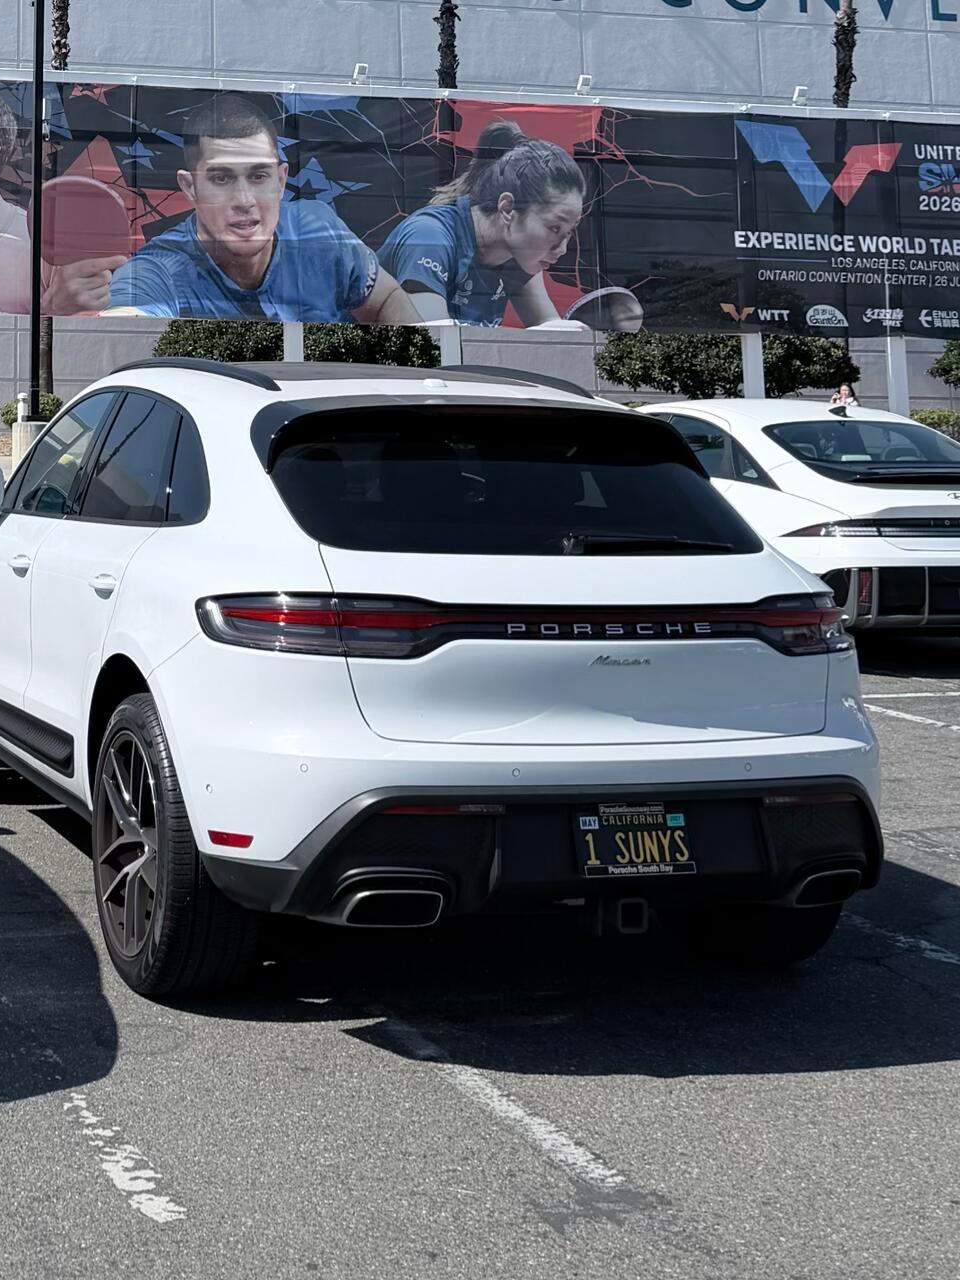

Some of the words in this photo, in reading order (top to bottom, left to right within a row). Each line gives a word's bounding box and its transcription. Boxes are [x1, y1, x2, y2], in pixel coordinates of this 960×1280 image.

[919, 195, 960, 212] 2026
[733, 230, 856, 252] EXPERIENCE
[858, 235, 927, 255] WORLD
[417, 256, 448, 282] JOOLA
[831, 257, 853, 268] LOS
[854, 258, 908, 272] ANGELES,
[757, 269, 807, 282] ONTARIO
[808, 270, 881, 284] CONVENTION
[884, 274, 927, 286] CENTER
[934, 276, 948, 287] 26
[758, 308, 790, 322] WTT
[506, 622, 712, 635] PORSCHE
[580, 817, 598, 828] MAY
[602, 814, 664, 825] CALIFORNIA
[584, 832, 601, 865] 1
[614, 829, 690, 864] SUNYS
[608, 865, 638, 874] Porsche
